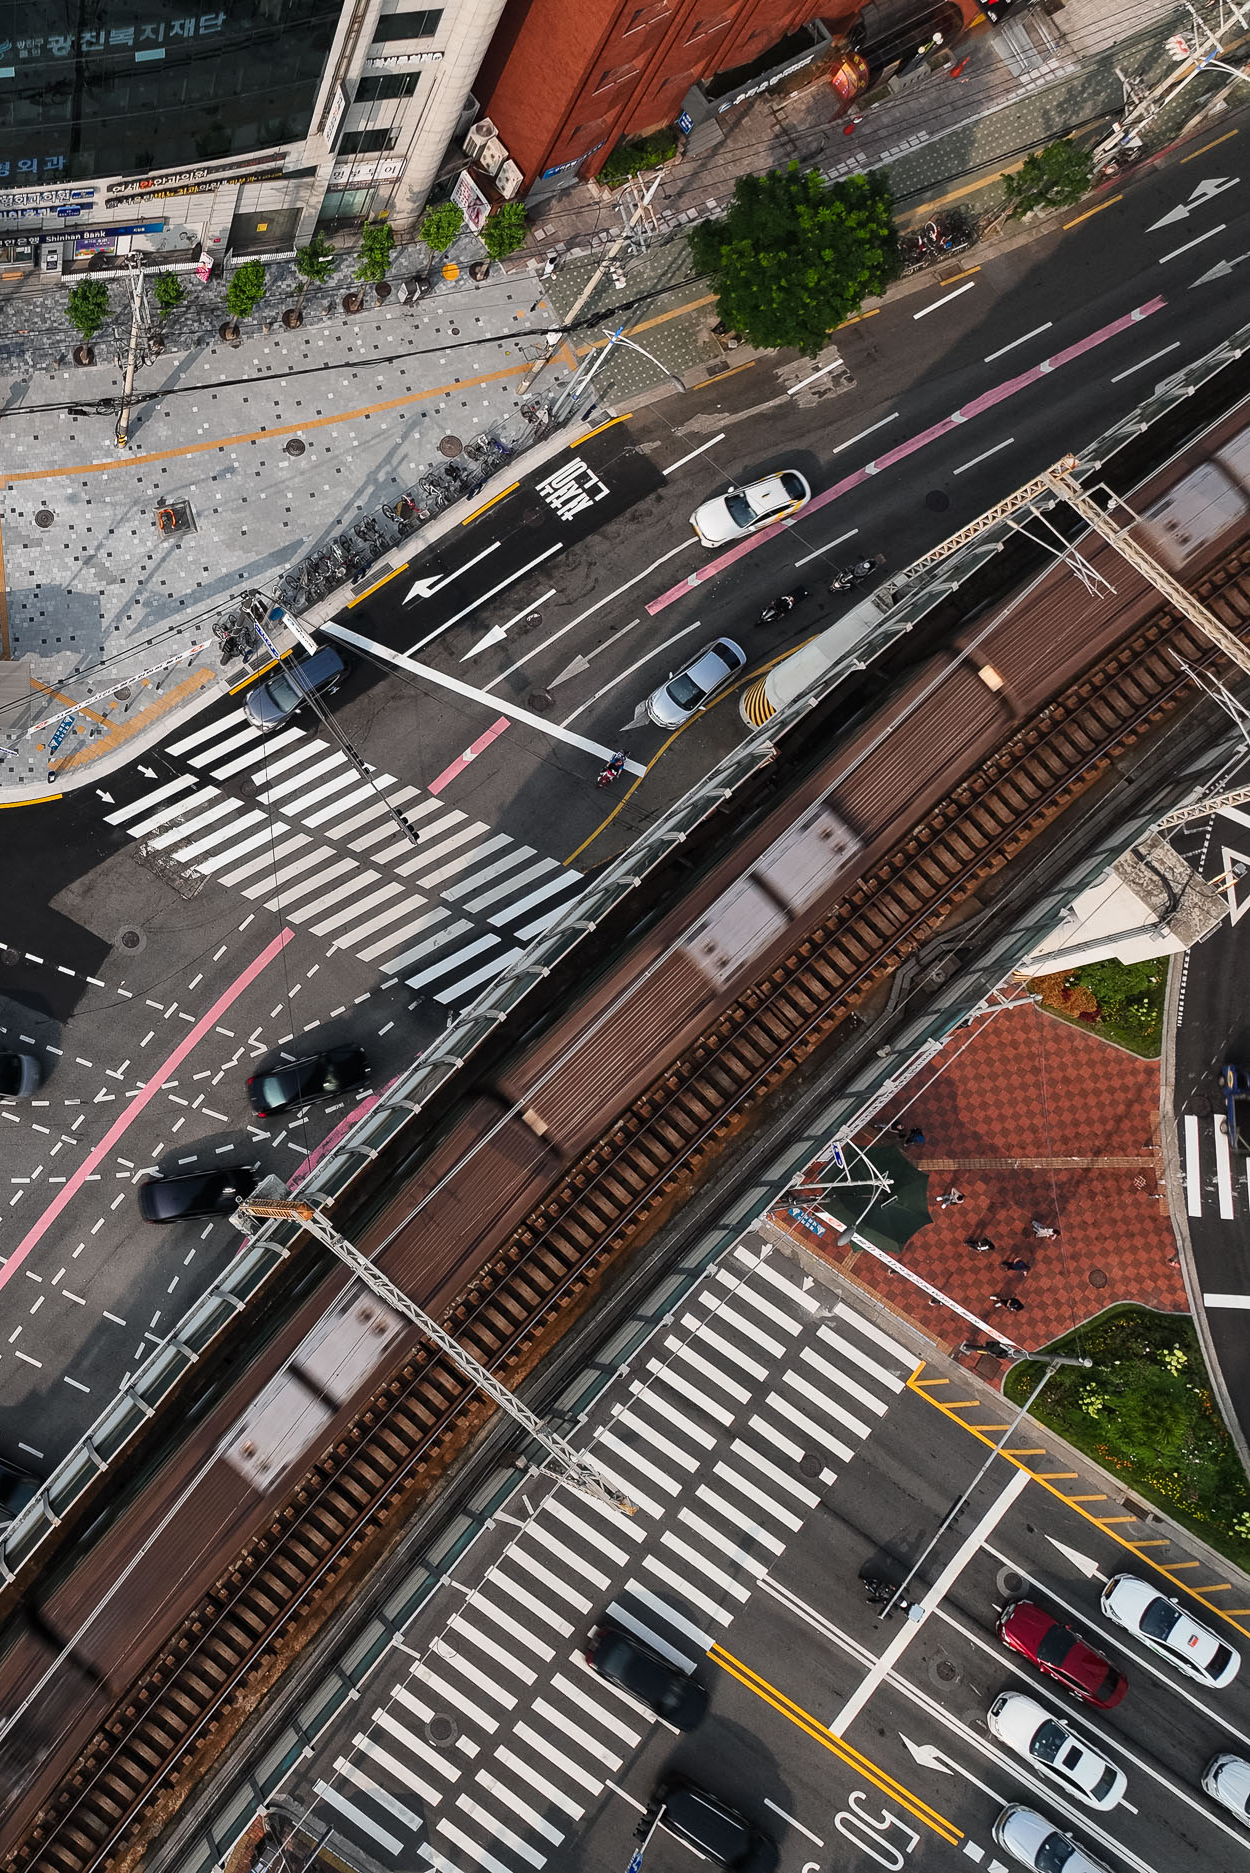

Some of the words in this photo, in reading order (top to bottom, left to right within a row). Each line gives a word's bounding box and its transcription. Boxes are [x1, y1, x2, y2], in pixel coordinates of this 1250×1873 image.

[46, 11, 227, 56] 광진복지재단
[45, 232, 81, 243] Shinhan
[84, 230, 106, 239] Bank
[534, 456, 611, 522] 천천히
[834, 1791, 921, 1873] 50
